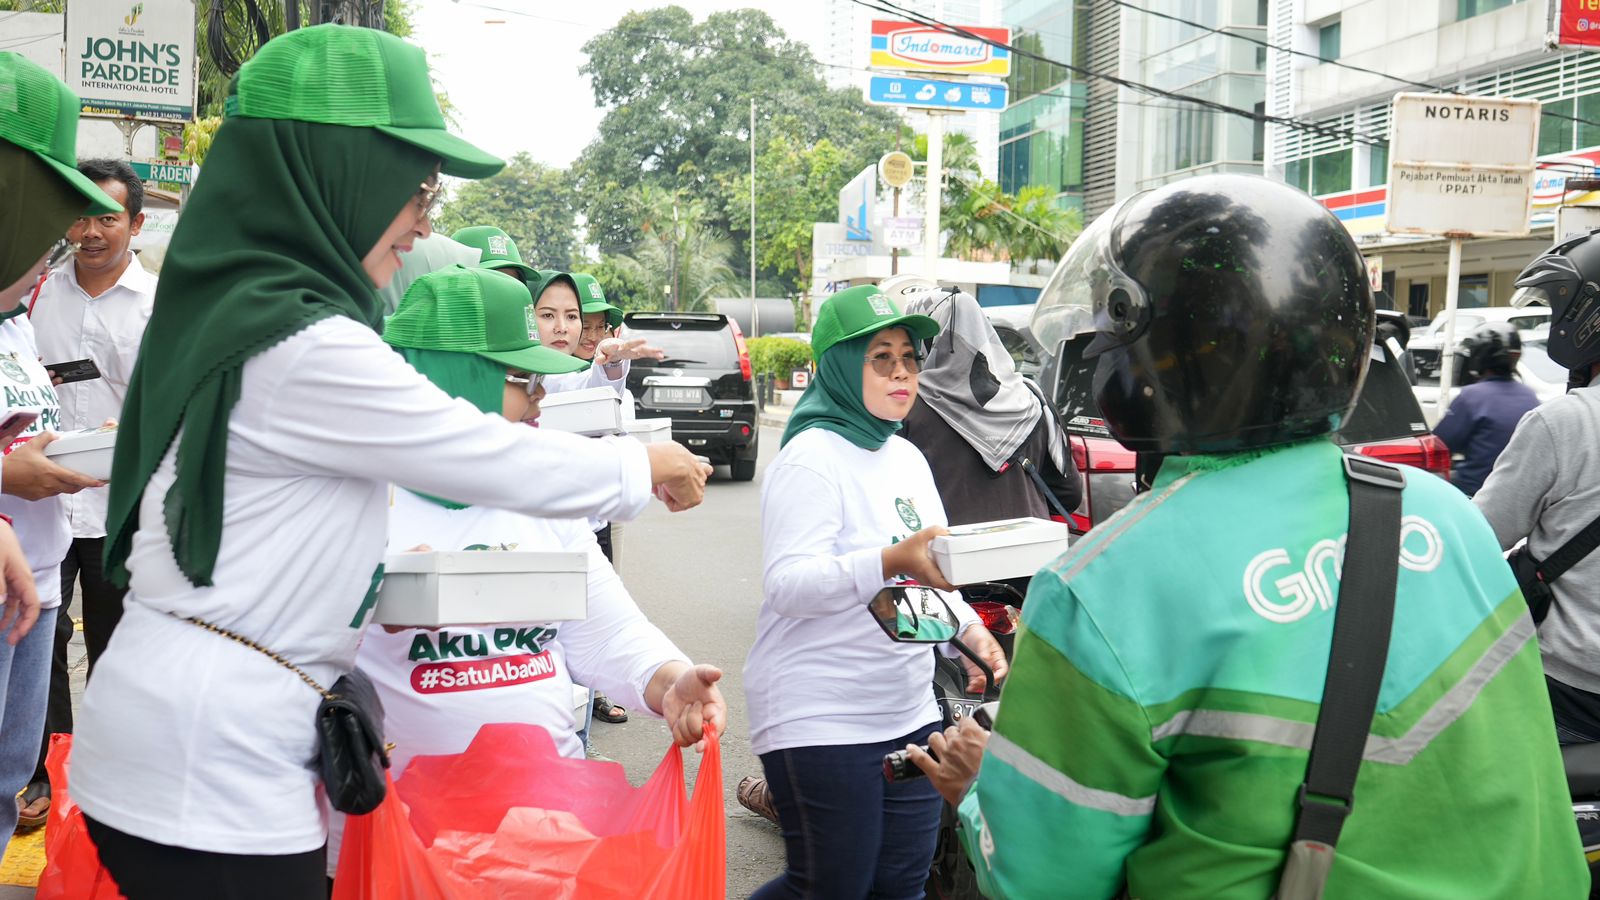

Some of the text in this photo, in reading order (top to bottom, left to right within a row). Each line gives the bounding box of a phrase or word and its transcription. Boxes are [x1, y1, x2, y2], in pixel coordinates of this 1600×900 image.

[81, 37, 181, 67] JOHN'S
[897, 35, 985, 57] Indomaret
[81, 61, 180, 86] PARDEDE
[81, 80, 178, 95] INTERNATIONAL HOTEL
[1425, 106, 1510, 122] NOTARIS
[150, 165, 190, 182] RADEN
[1400, 171, 1523, 185] Pejabat Pembuat Akta Tanah
[890, 230, 915, 239] ATM
[4, 385, 40, 408] Aku
[41, 408, 60, 431] PK
[408, 631, 488, 661] Aku
[419, 653, 554, 689] #SatuAbadNU
